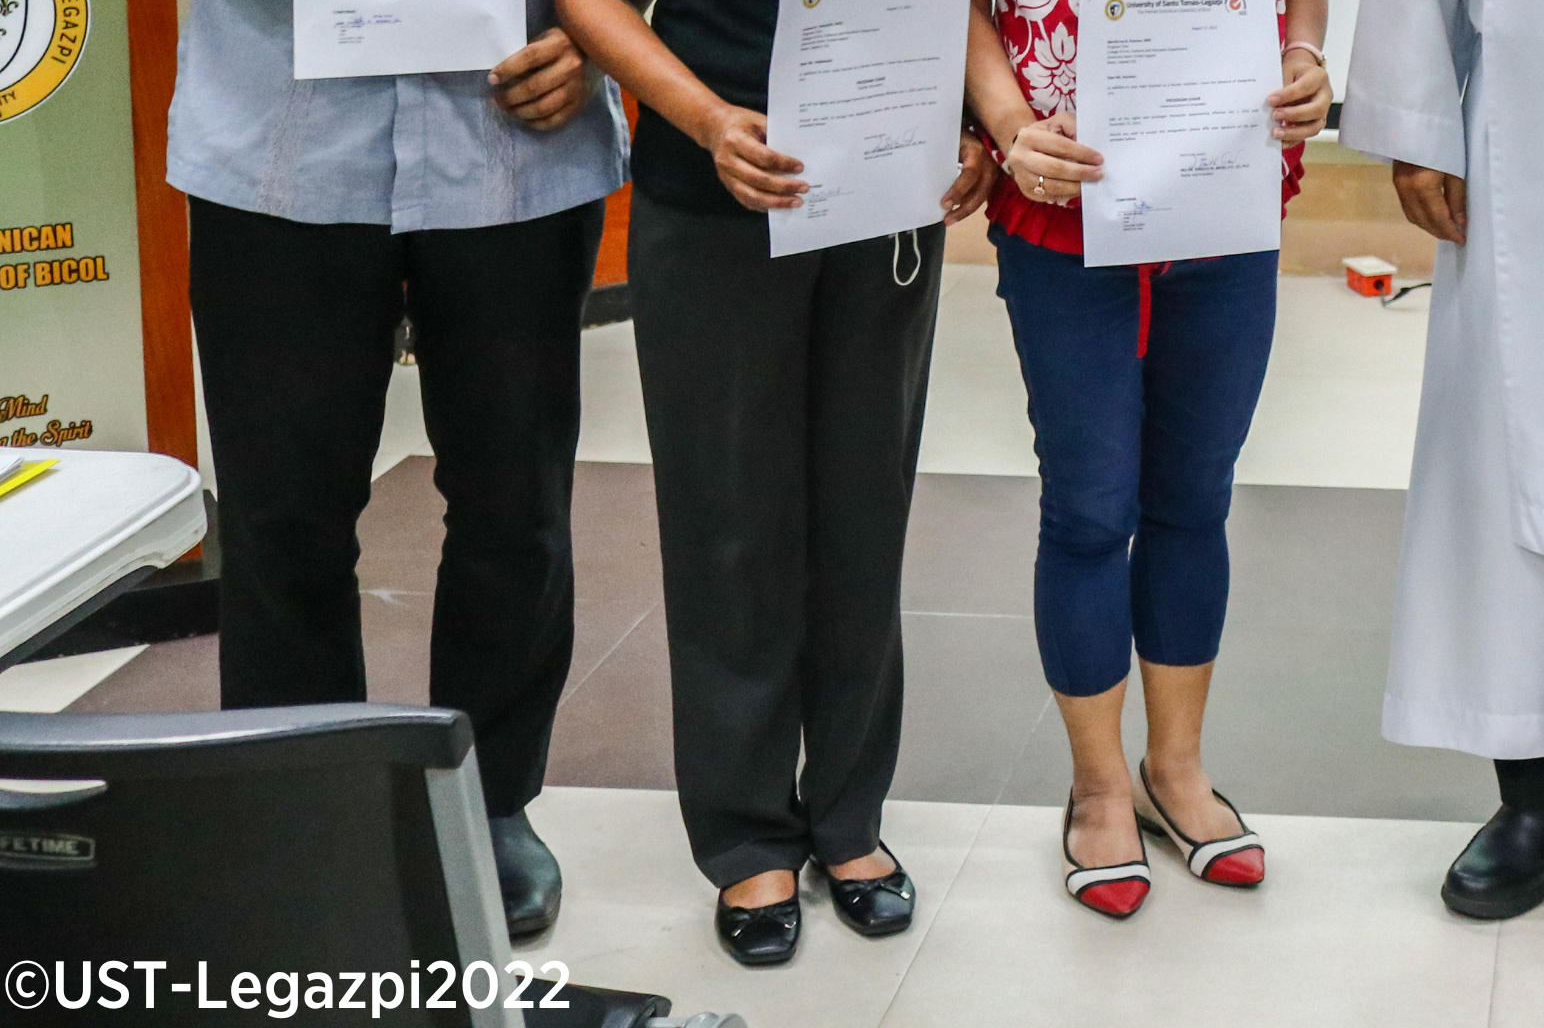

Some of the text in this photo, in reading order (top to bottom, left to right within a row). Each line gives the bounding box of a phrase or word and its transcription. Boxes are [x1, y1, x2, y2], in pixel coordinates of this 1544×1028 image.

[1126, 1, 1155, 9] University
[0, 255, 110, 290] OF BICOL
[0, 394, 49, 423] Mind
[11, 427, 38, 447] the
[40, 419, 93, 447] Spirit
